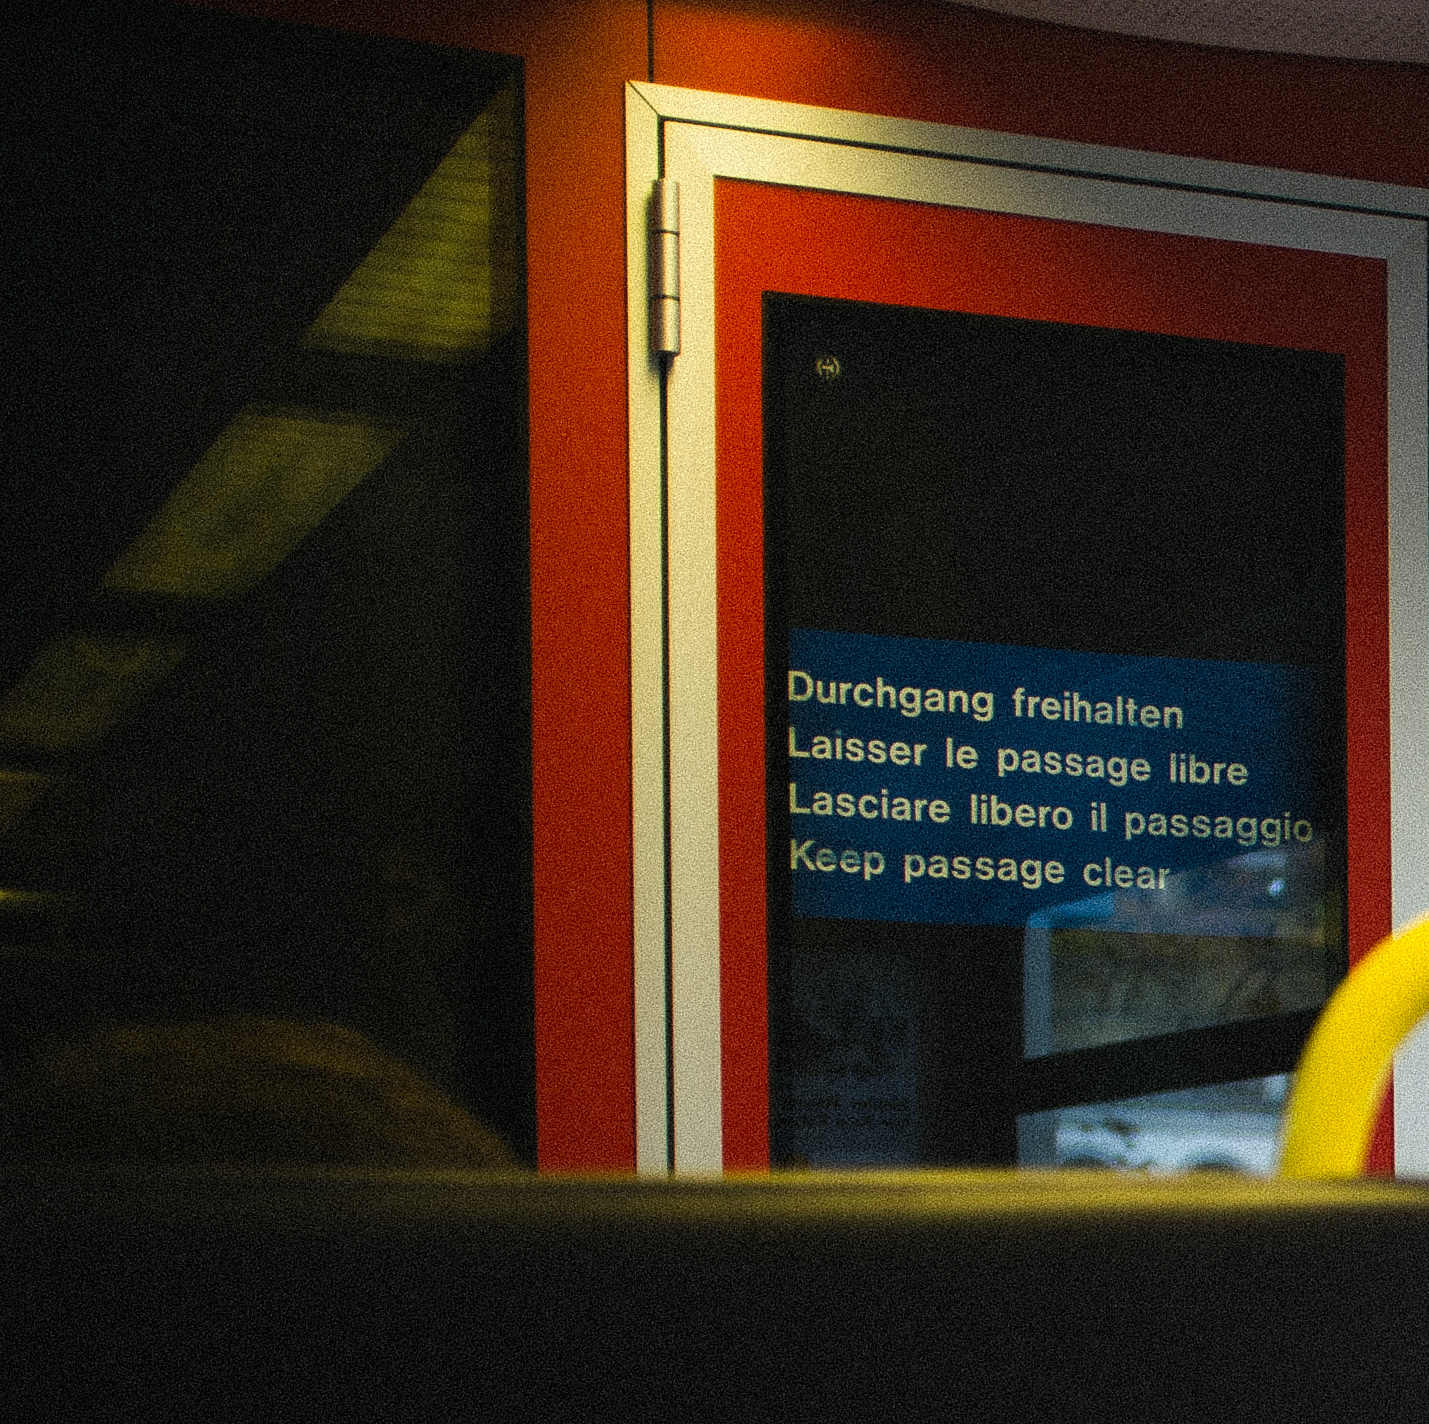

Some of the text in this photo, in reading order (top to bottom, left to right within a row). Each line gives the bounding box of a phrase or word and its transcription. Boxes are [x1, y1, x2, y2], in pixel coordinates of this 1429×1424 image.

[787, 669, 1184, 729] Durchgang freihalten
[788, 727, 1247, 787] Laisser le passage libre
[788, 782, 1313, 847] Lasciare libero il passaggio
[790, 839, 1169, 895] Keep passage clear
